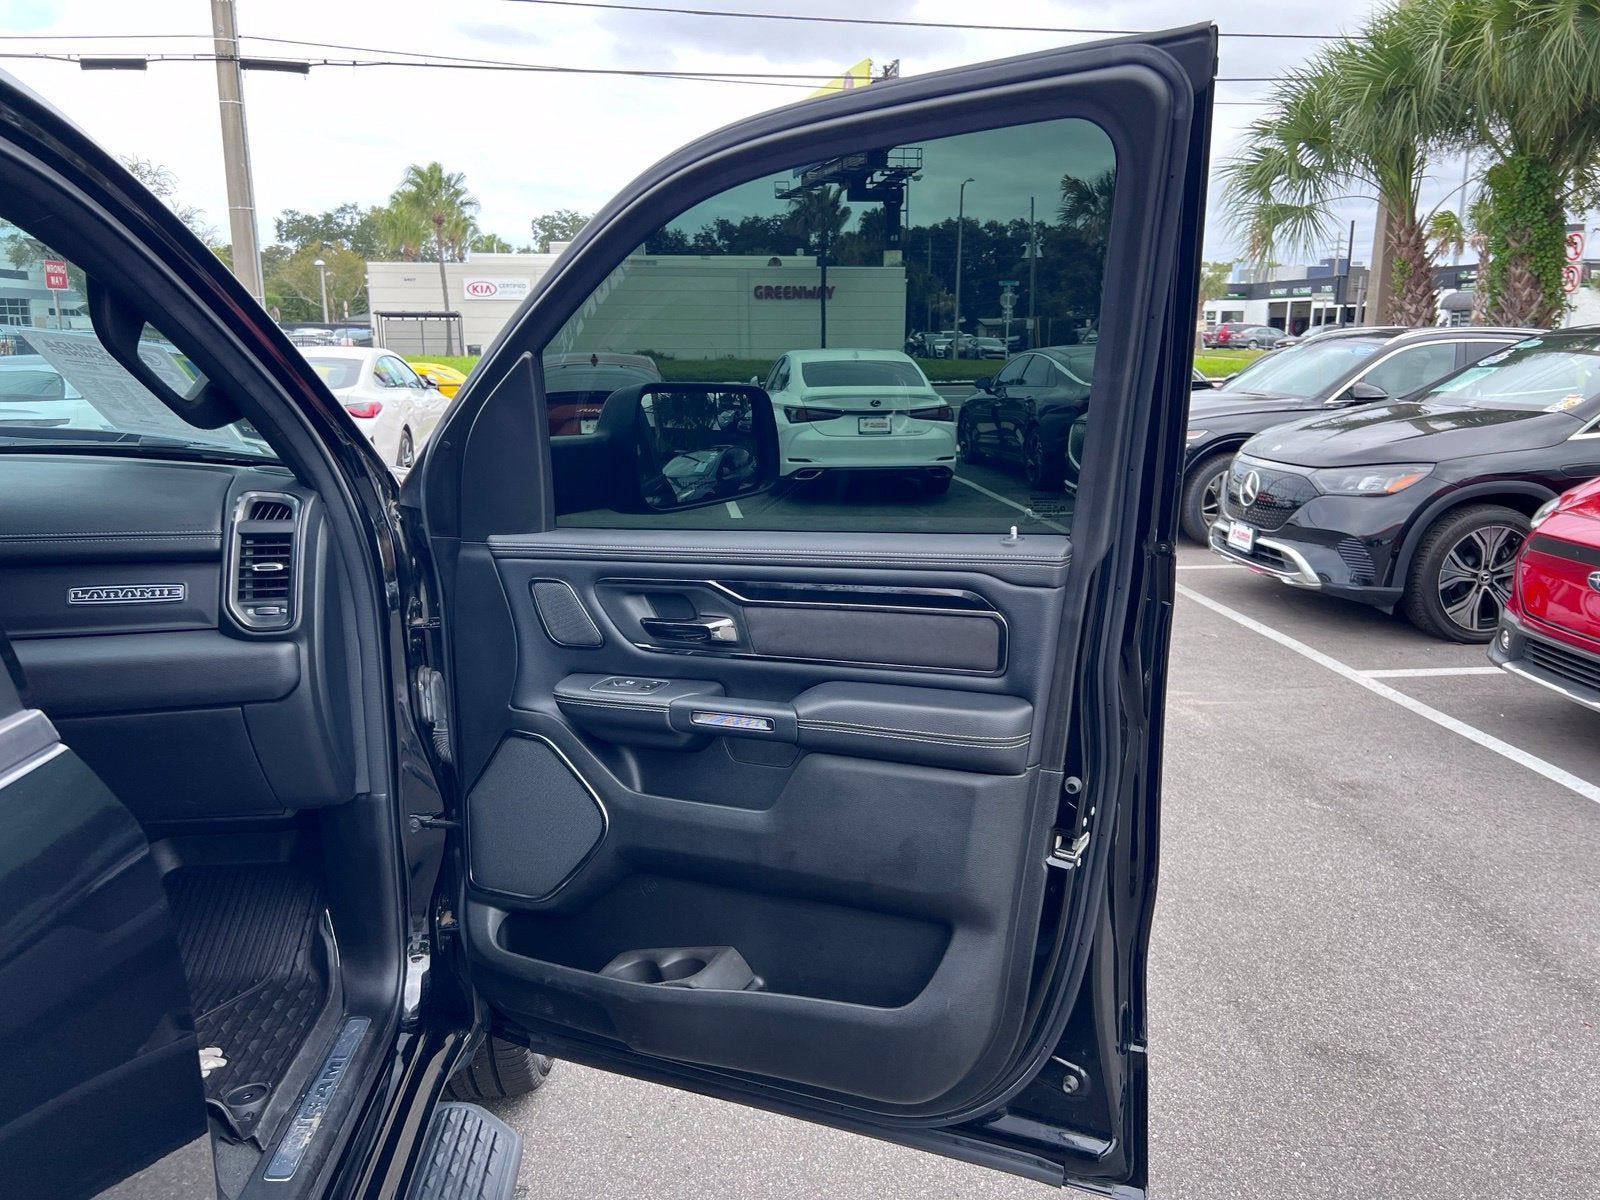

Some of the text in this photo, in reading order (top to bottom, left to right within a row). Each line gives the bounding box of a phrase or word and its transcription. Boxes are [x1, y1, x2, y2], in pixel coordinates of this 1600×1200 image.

[46, 264, 66, 274] WRONG
[50, 276, 63, 285] WAY
[471, 284, 492, 294] KIA
[753, 285, 836, 300] GREENWAY
[71, 587, 182, 600] LARAMIE
